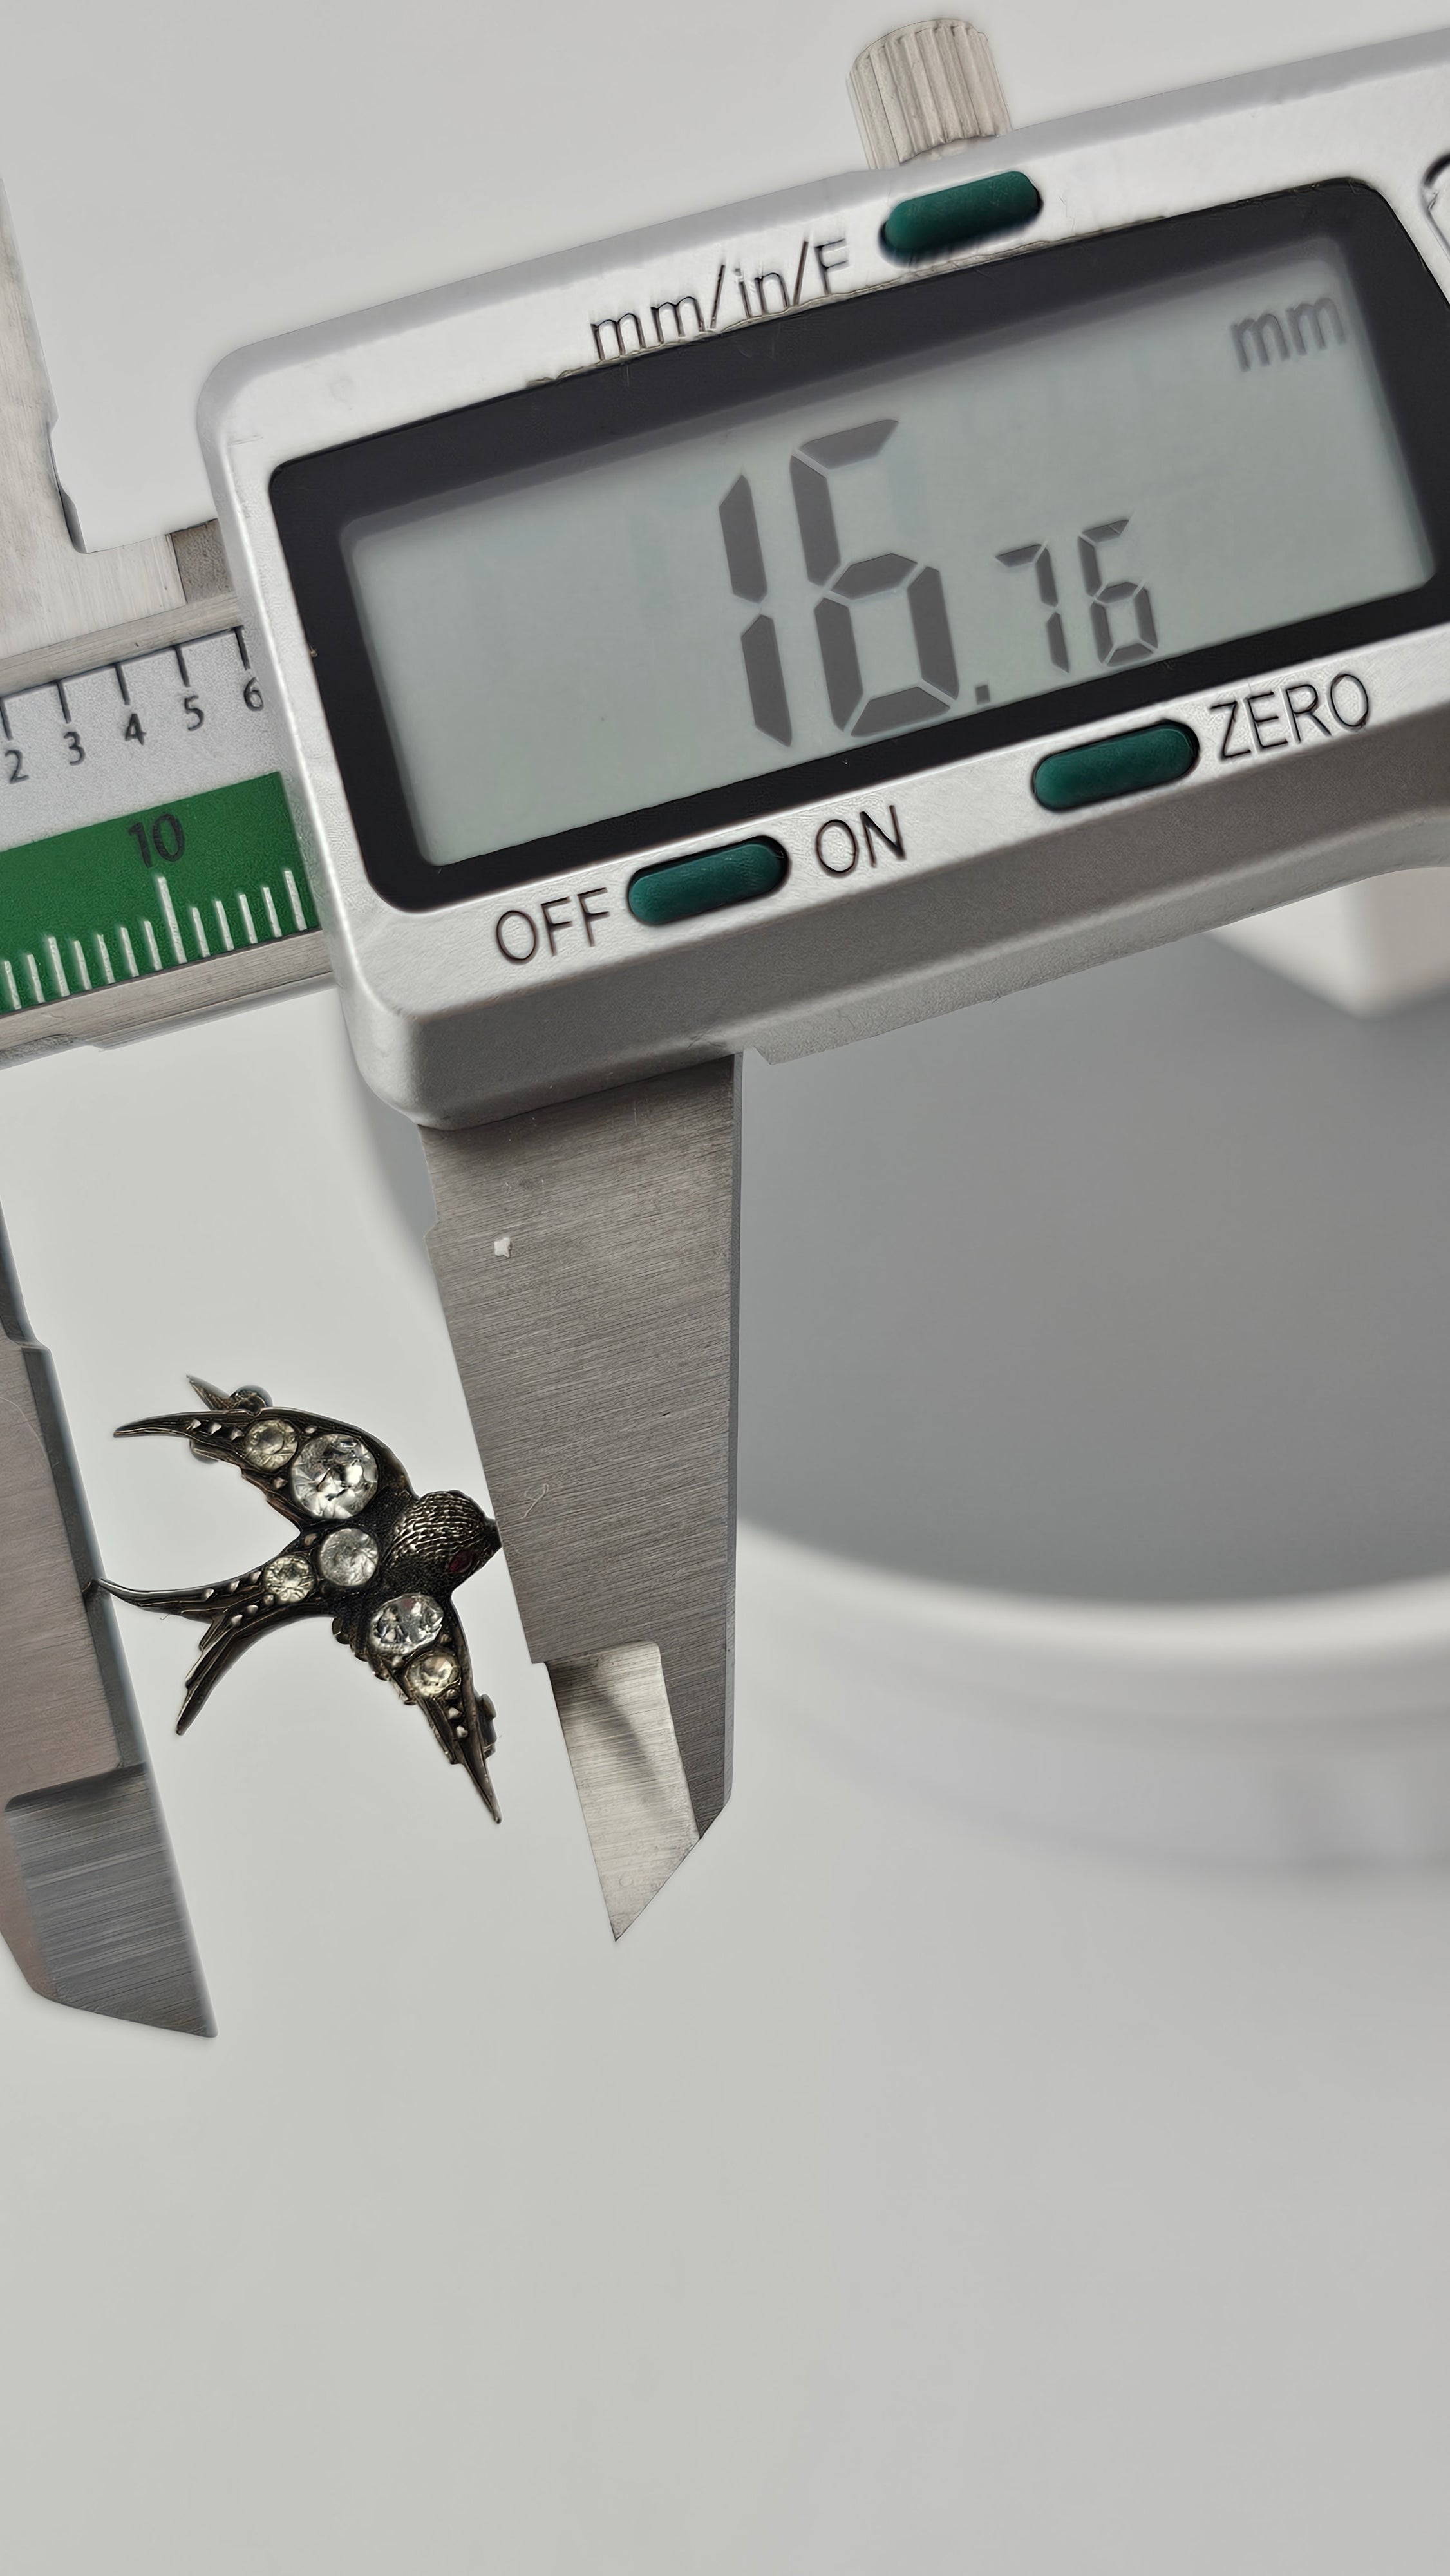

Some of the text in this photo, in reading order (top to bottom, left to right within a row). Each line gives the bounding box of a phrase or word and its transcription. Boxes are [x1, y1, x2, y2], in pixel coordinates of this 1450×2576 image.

[590, 236, 849, 362] mm/in/F
[1230, 292, 1346, 372] mm
[719, 419, 1159, 746] 16.76
[4, 677, 265, 784] 2 3 4 5 6
[1210, 673, 1371, 766] ZERO
[127, 812, 186, 868] 10
[814, 803, 907, 875] ON
[494, 884, 610, 965] OFF
